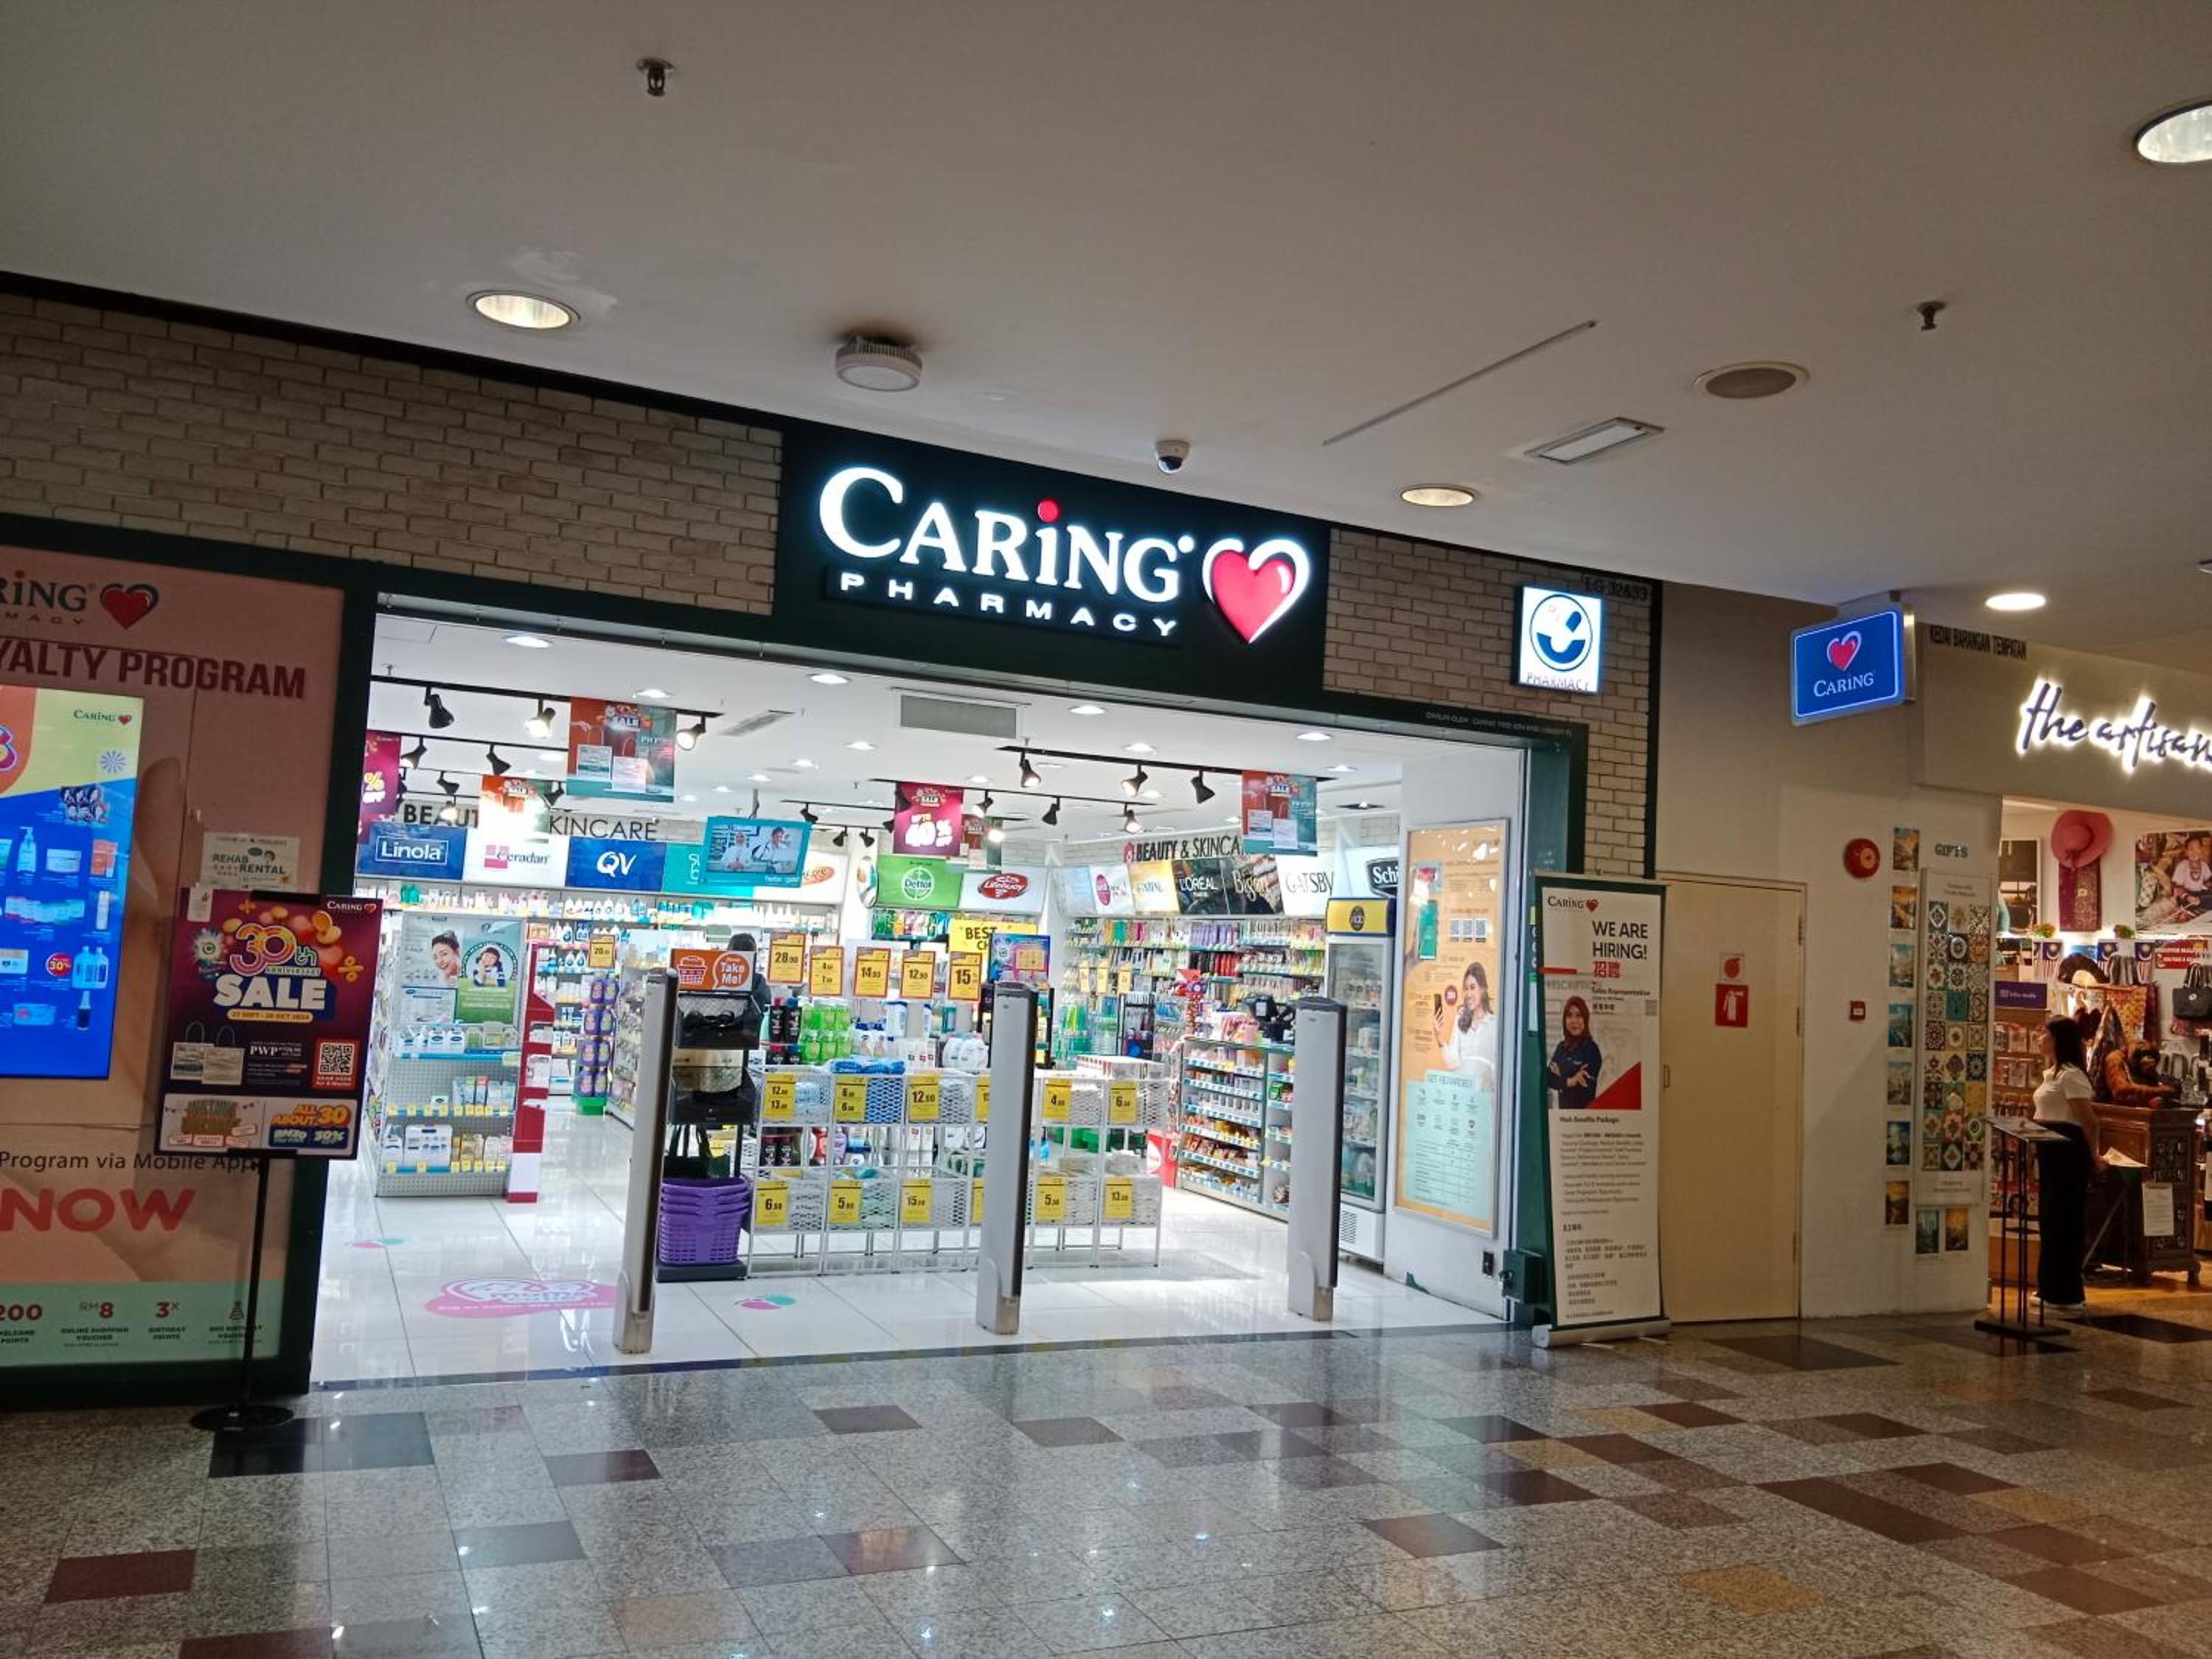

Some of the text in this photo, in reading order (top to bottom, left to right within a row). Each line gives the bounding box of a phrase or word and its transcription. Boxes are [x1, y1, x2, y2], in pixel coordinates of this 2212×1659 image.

[841, 572, 1180, 636] PHARMACY
[1930, 625, 2028, 661] KEDAI BARANGAN TEMPATAN
[117, 650, 305, 699] PROGRAM
[2023, 682, 2089, 750] the
[380, 841, 442, 861] Linola
[1135, 835, 1245, 862] BEAUTY & SKINCA
[1934, 844, 1969, 860] GIFTS
[212, 853, 249, 864] REHAB
[596, 850, 637, 878] QV
[239, 863, 285, 874] RENTAL
[904, 878, 933, 889] Dettol
[984, 880, 1026, 892] Lifebuoy
[1285, 872, 1335, 897] GATSBY
[964, 926, 998, 940] BEST
[1592, 921, 1649, 939] WE ARE
[1592, 942, 1648, 960] HIRING!
[720, 962, 745, 973] Take
[1593, 961, 1621, 978] 招聘
[721, 973, 742, 984] Me!
[213, 973, 327, 1011] SALE
[249, 1045, 278, 1057] PWP
[318, 1105, 349, 1126] 30
[0, 1150, 89, 1173] Program
[97, 1152, 126, 1169] via
[133, 1152, 206, 1170] Mobile
[0, 1188, 197, 1232] NOW
